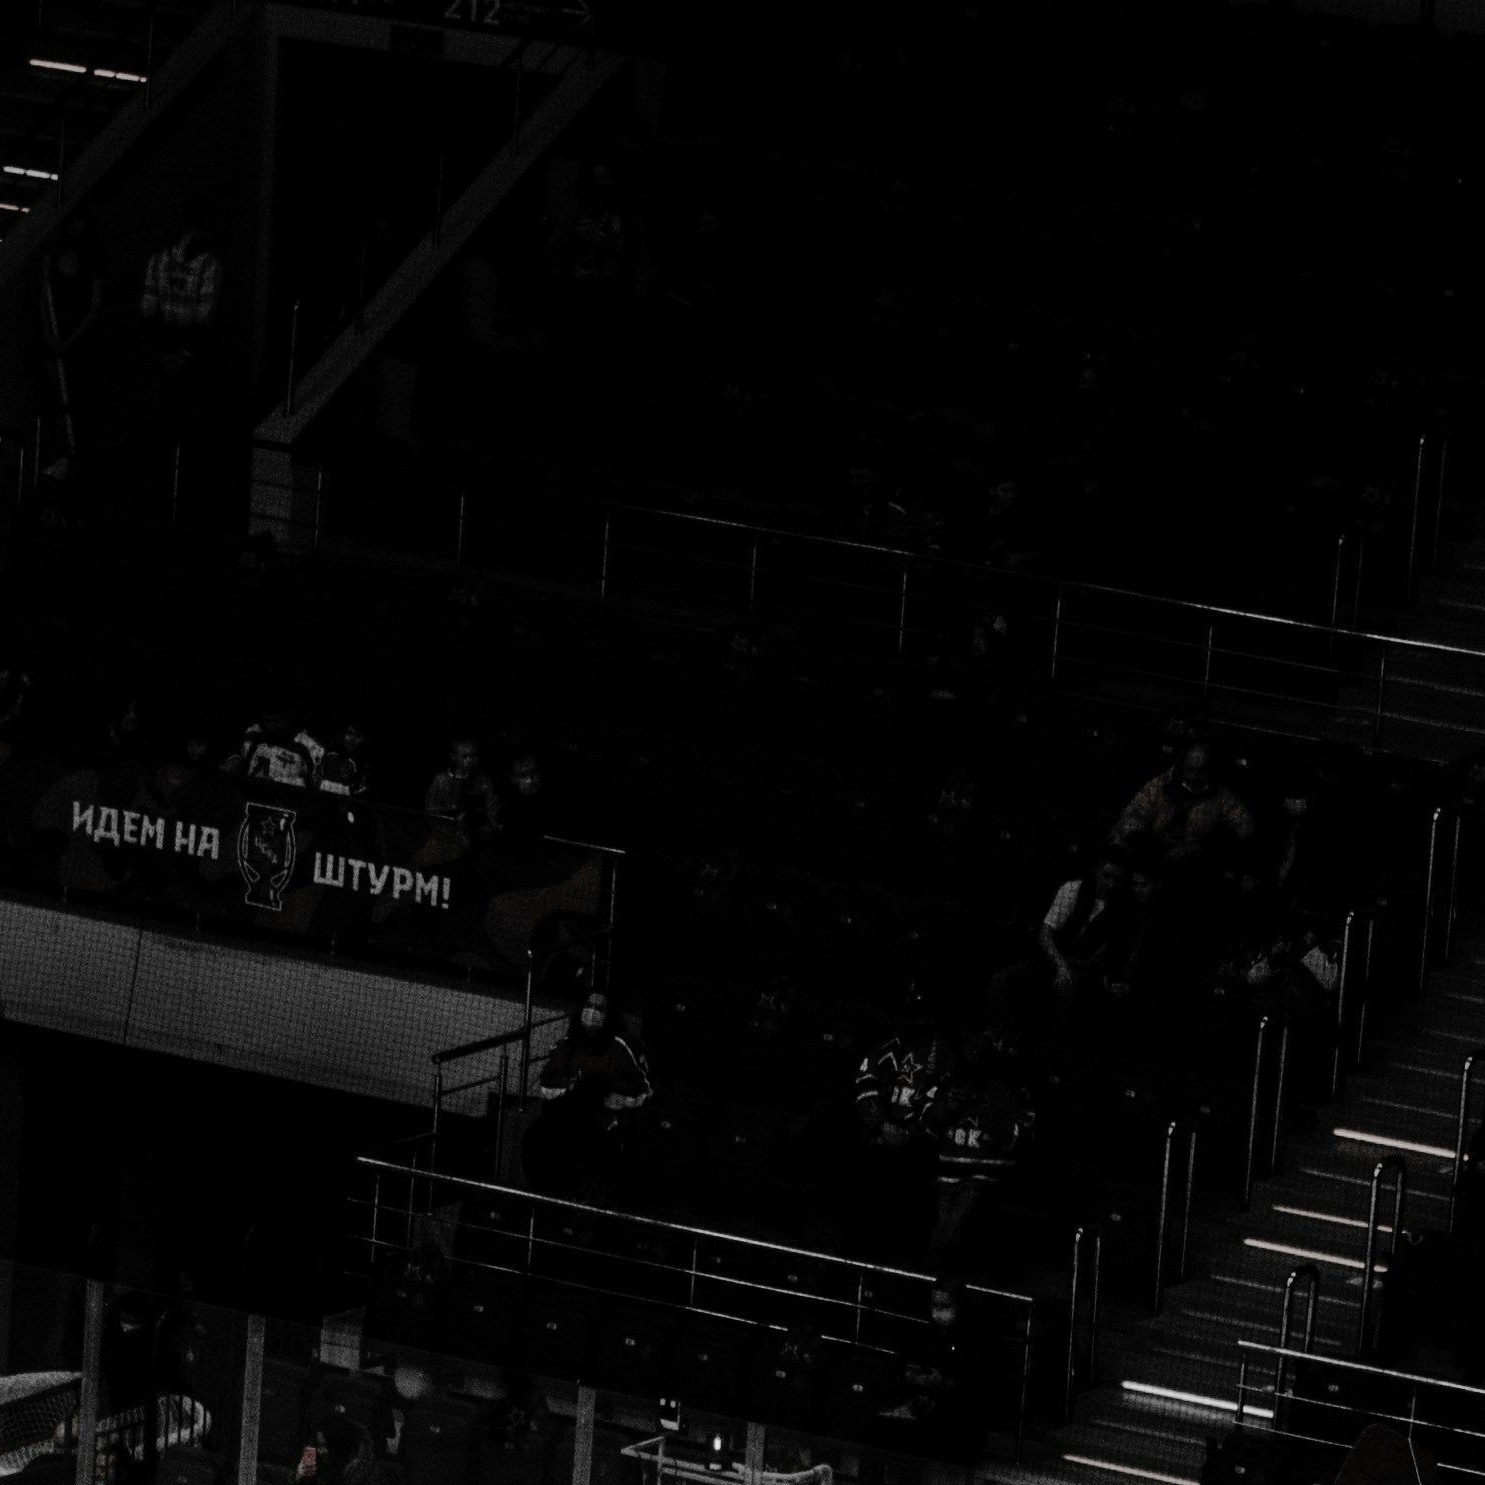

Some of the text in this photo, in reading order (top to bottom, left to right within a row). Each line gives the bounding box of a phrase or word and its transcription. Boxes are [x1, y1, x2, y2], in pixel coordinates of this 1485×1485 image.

[71, 800, 220, 860] ИДЕМ НА
[313, 850, 452, 910] ШТУРМ!
